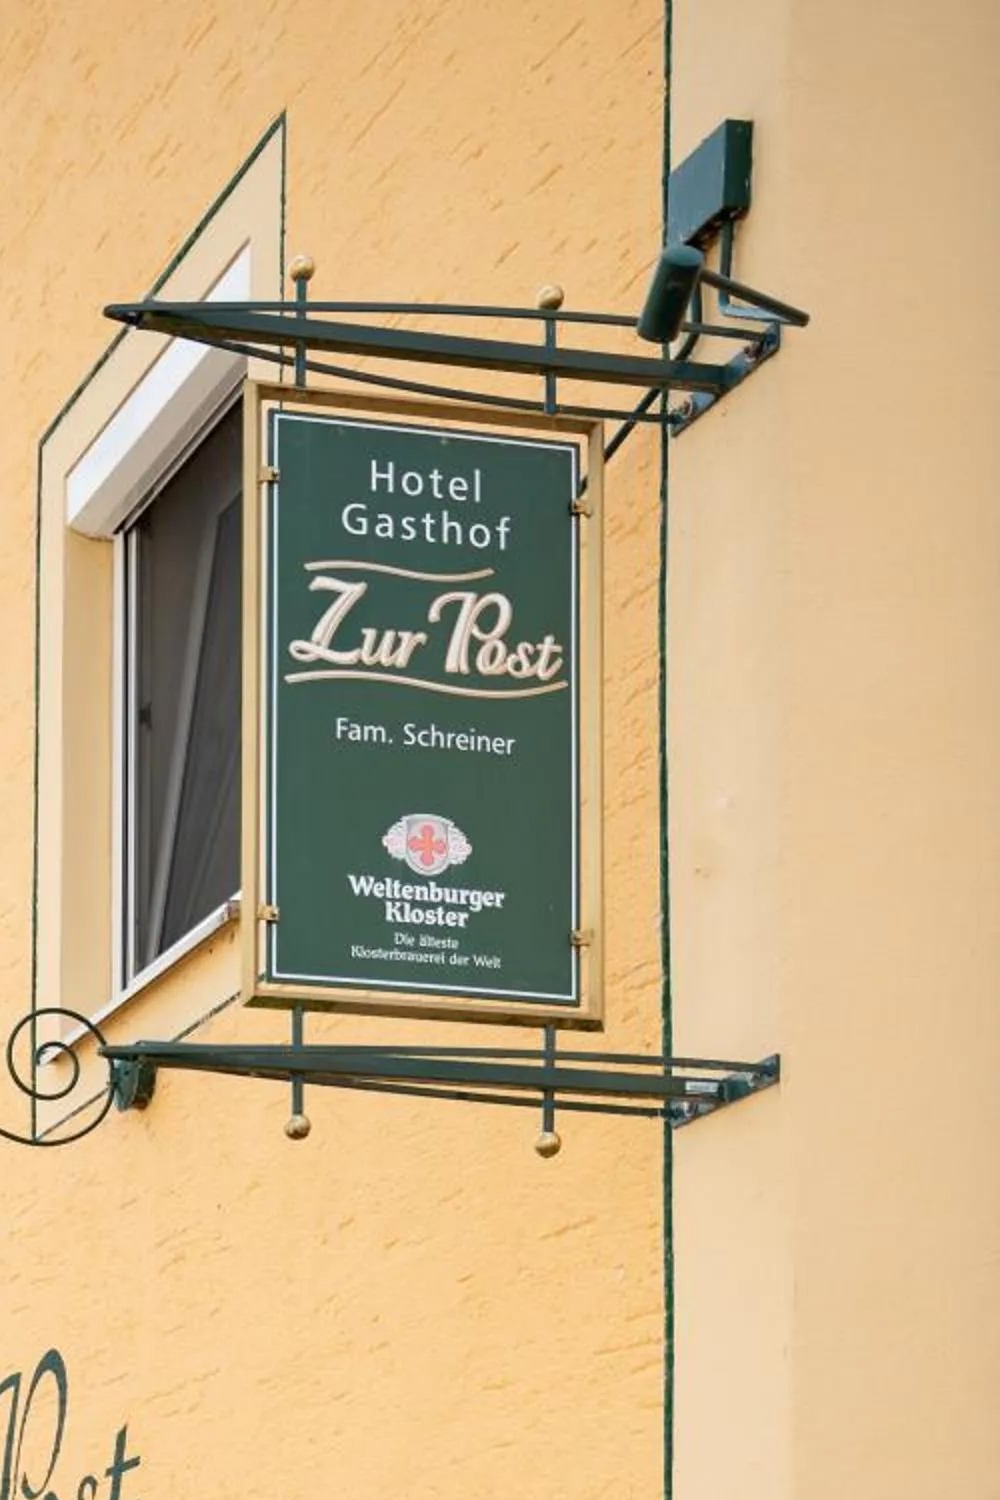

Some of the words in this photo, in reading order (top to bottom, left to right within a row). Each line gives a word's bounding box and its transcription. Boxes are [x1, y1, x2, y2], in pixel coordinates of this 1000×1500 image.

[370, 459, 482, 503] Hotel
[341, 503, 512, 550] Gasthof
[288, 575, 429, 669] Zur
[427, 591, 565, 681] Post
[335, 717, 394, 744] Fam.
[403, 723, 517, 755] Schreiner
[347, 874, 505, 913] Weltenburger
[384, 901, 470, 928] Kloster
[350, 945, 446, 965] Klosterbrauerei
[449, 952, 470, 966] der
[472, 954, 502, 969] Welt
[394, 931, 415, 946] Die
